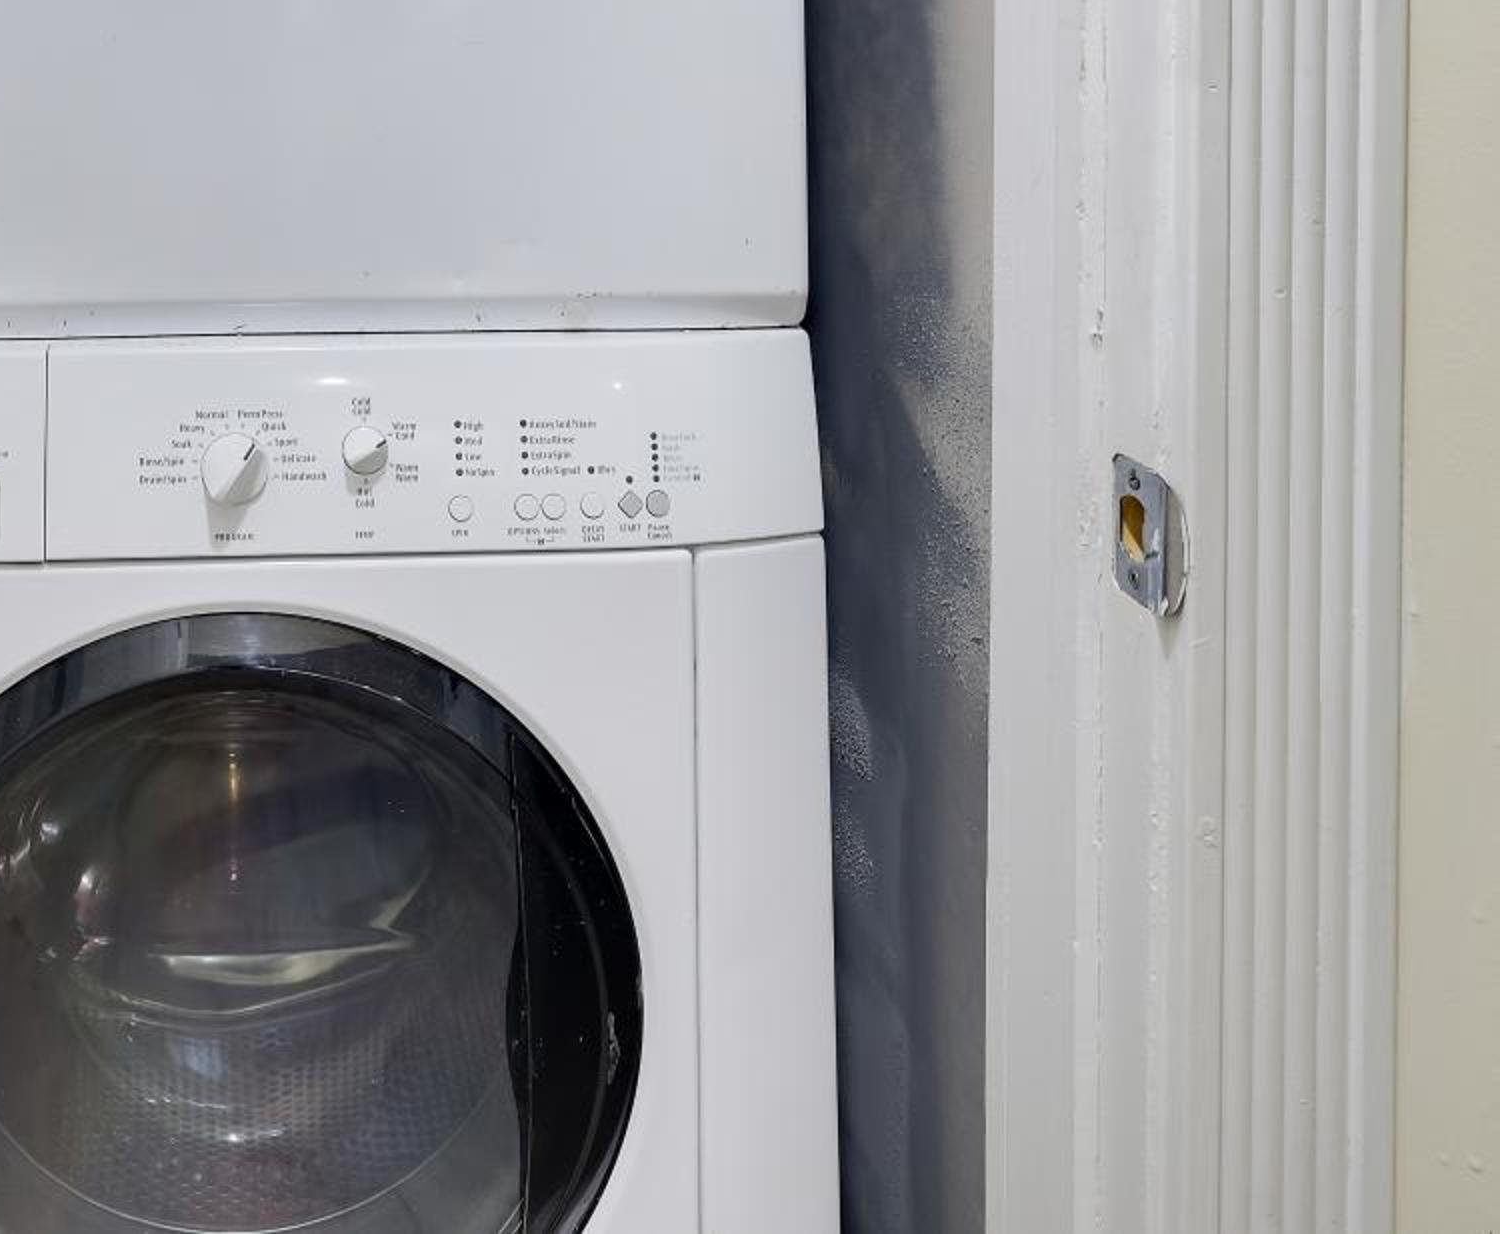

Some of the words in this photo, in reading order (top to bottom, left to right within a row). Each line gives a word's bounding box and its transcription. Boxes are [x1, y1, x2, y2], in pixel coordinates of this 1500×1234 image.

[195, 409, 229, 419] Normal
[261, 421, 287, 432] Quick
[171, 439, 192, 449] Soak
[281, 453, 316, 464] Delicate
[282, 471, 328, 482] Handwash
